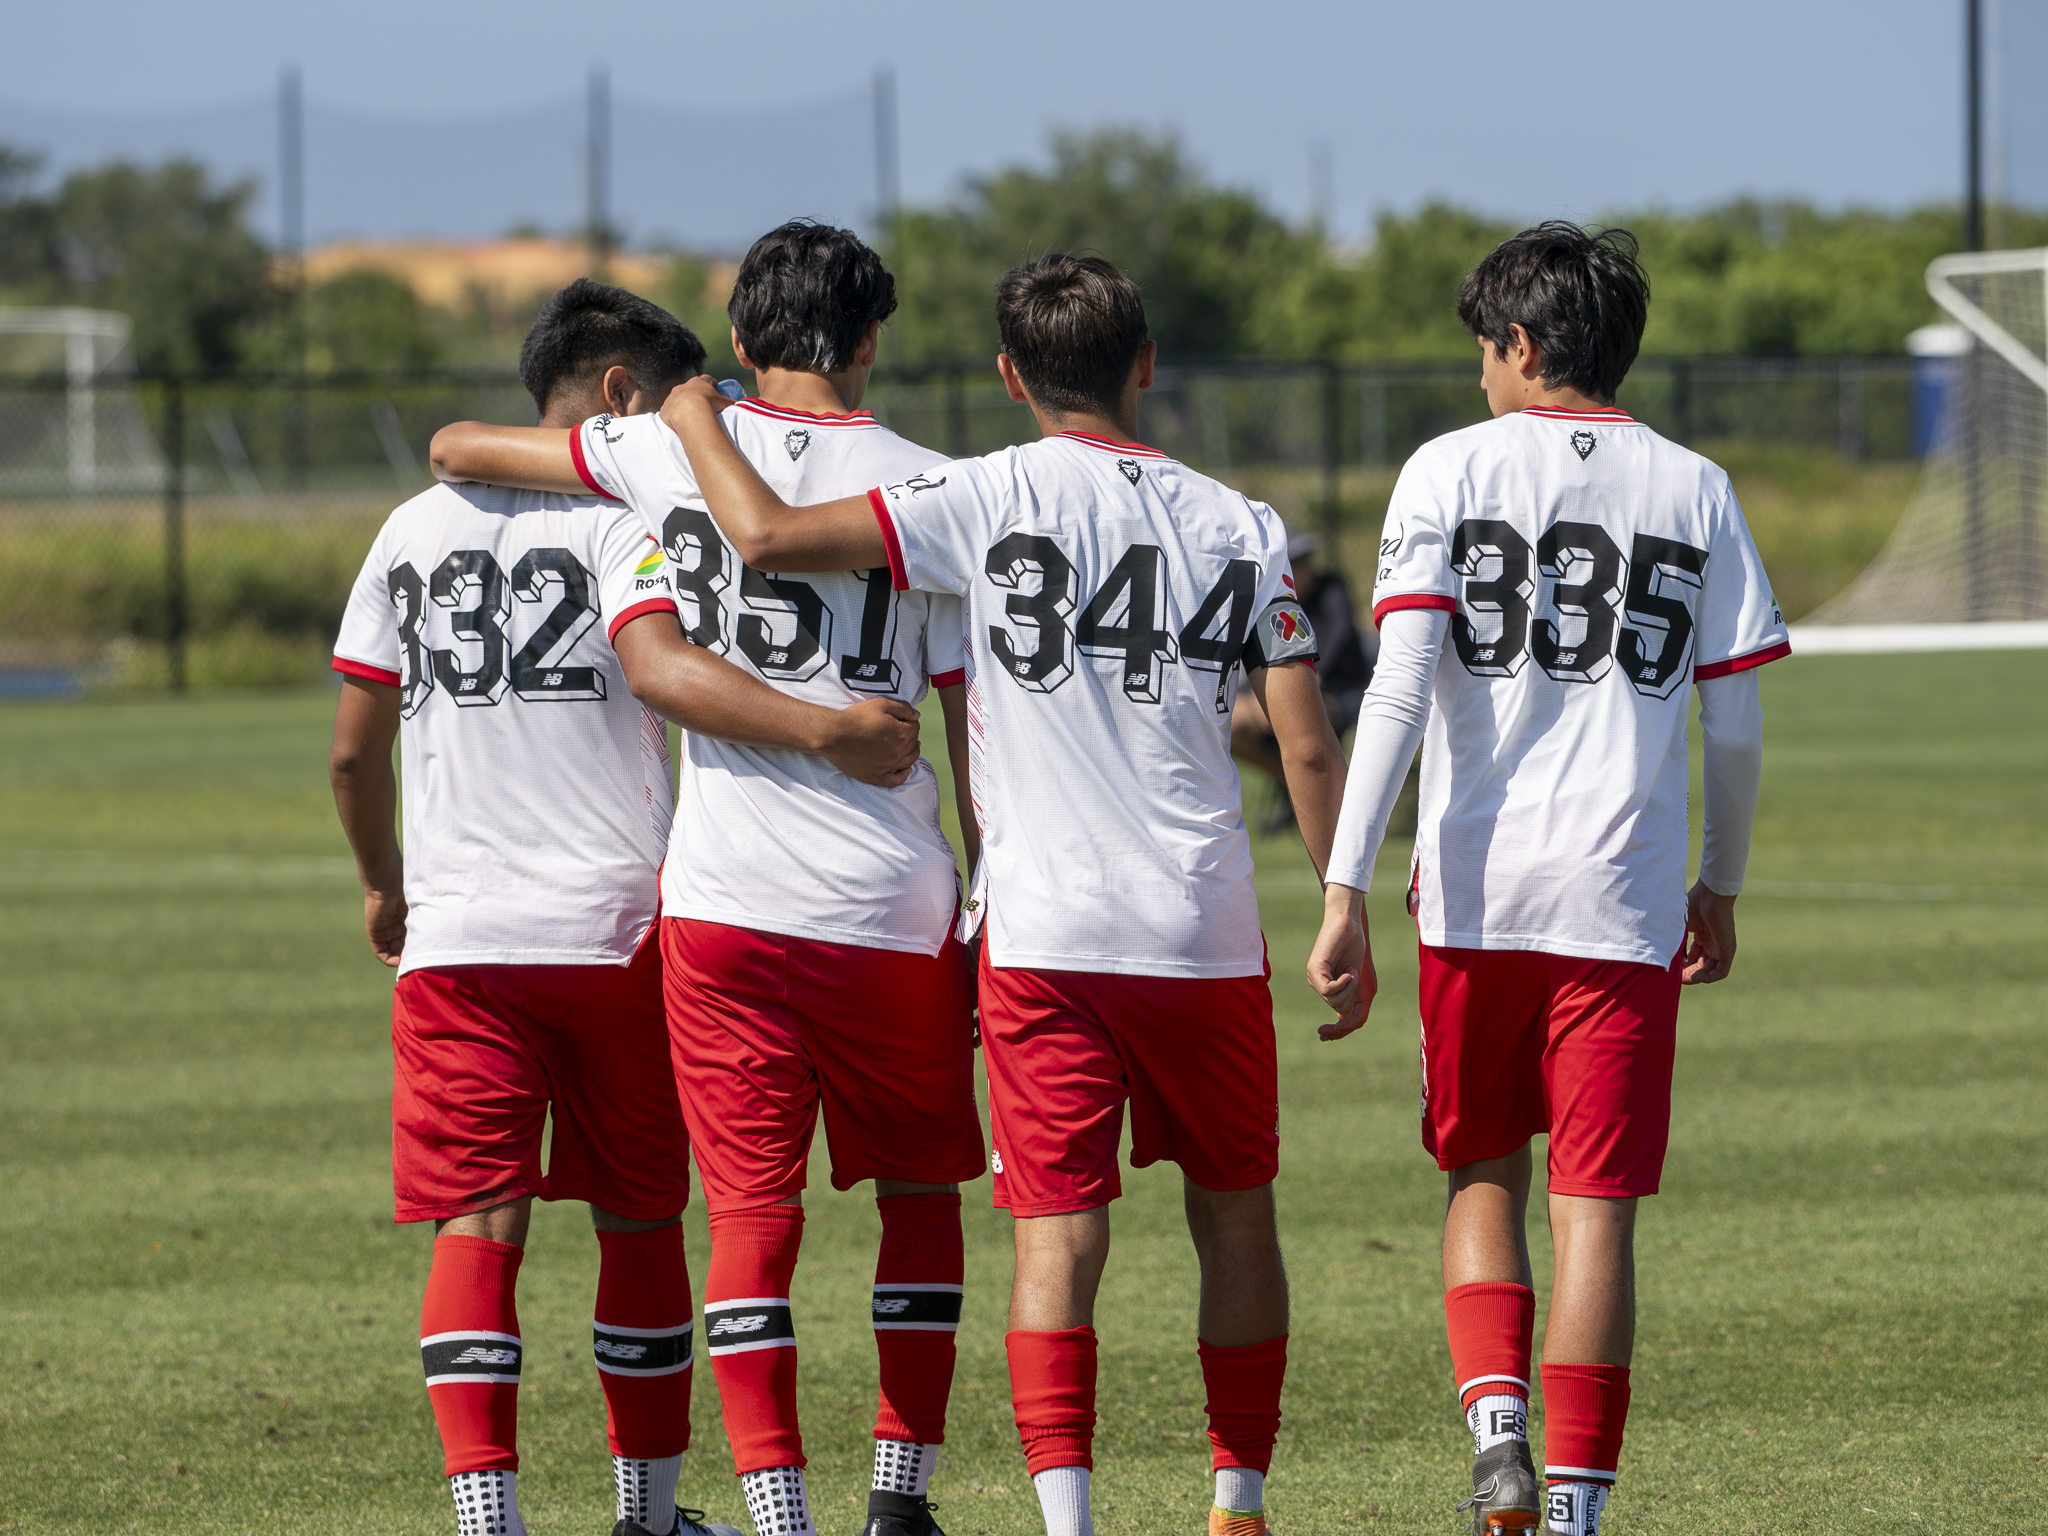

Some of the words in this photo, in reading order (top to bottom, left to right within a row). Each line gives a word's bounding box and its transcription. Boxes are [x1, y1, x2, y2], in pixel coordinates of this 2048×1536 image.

[663, 506, 902, 693] 351
[1450, 519, 1709, 701] 335
[985, 532, 1262, 714] 344
[388, 548, 607, 720] 332
[766, 651, 789, 664] NB
[1472, 649, 1496, 661] NB
[1553, 652, 1578, 665] NB
[855, 664, 878, 677] NB
[1638, 666, 1658, 680] NB
[459, 678, 478, 691] NB
[542, 673, 564, 686] NB
[1125, 672, 1149, 686] NB
[1495, 1411, 1526, 1438] FS
